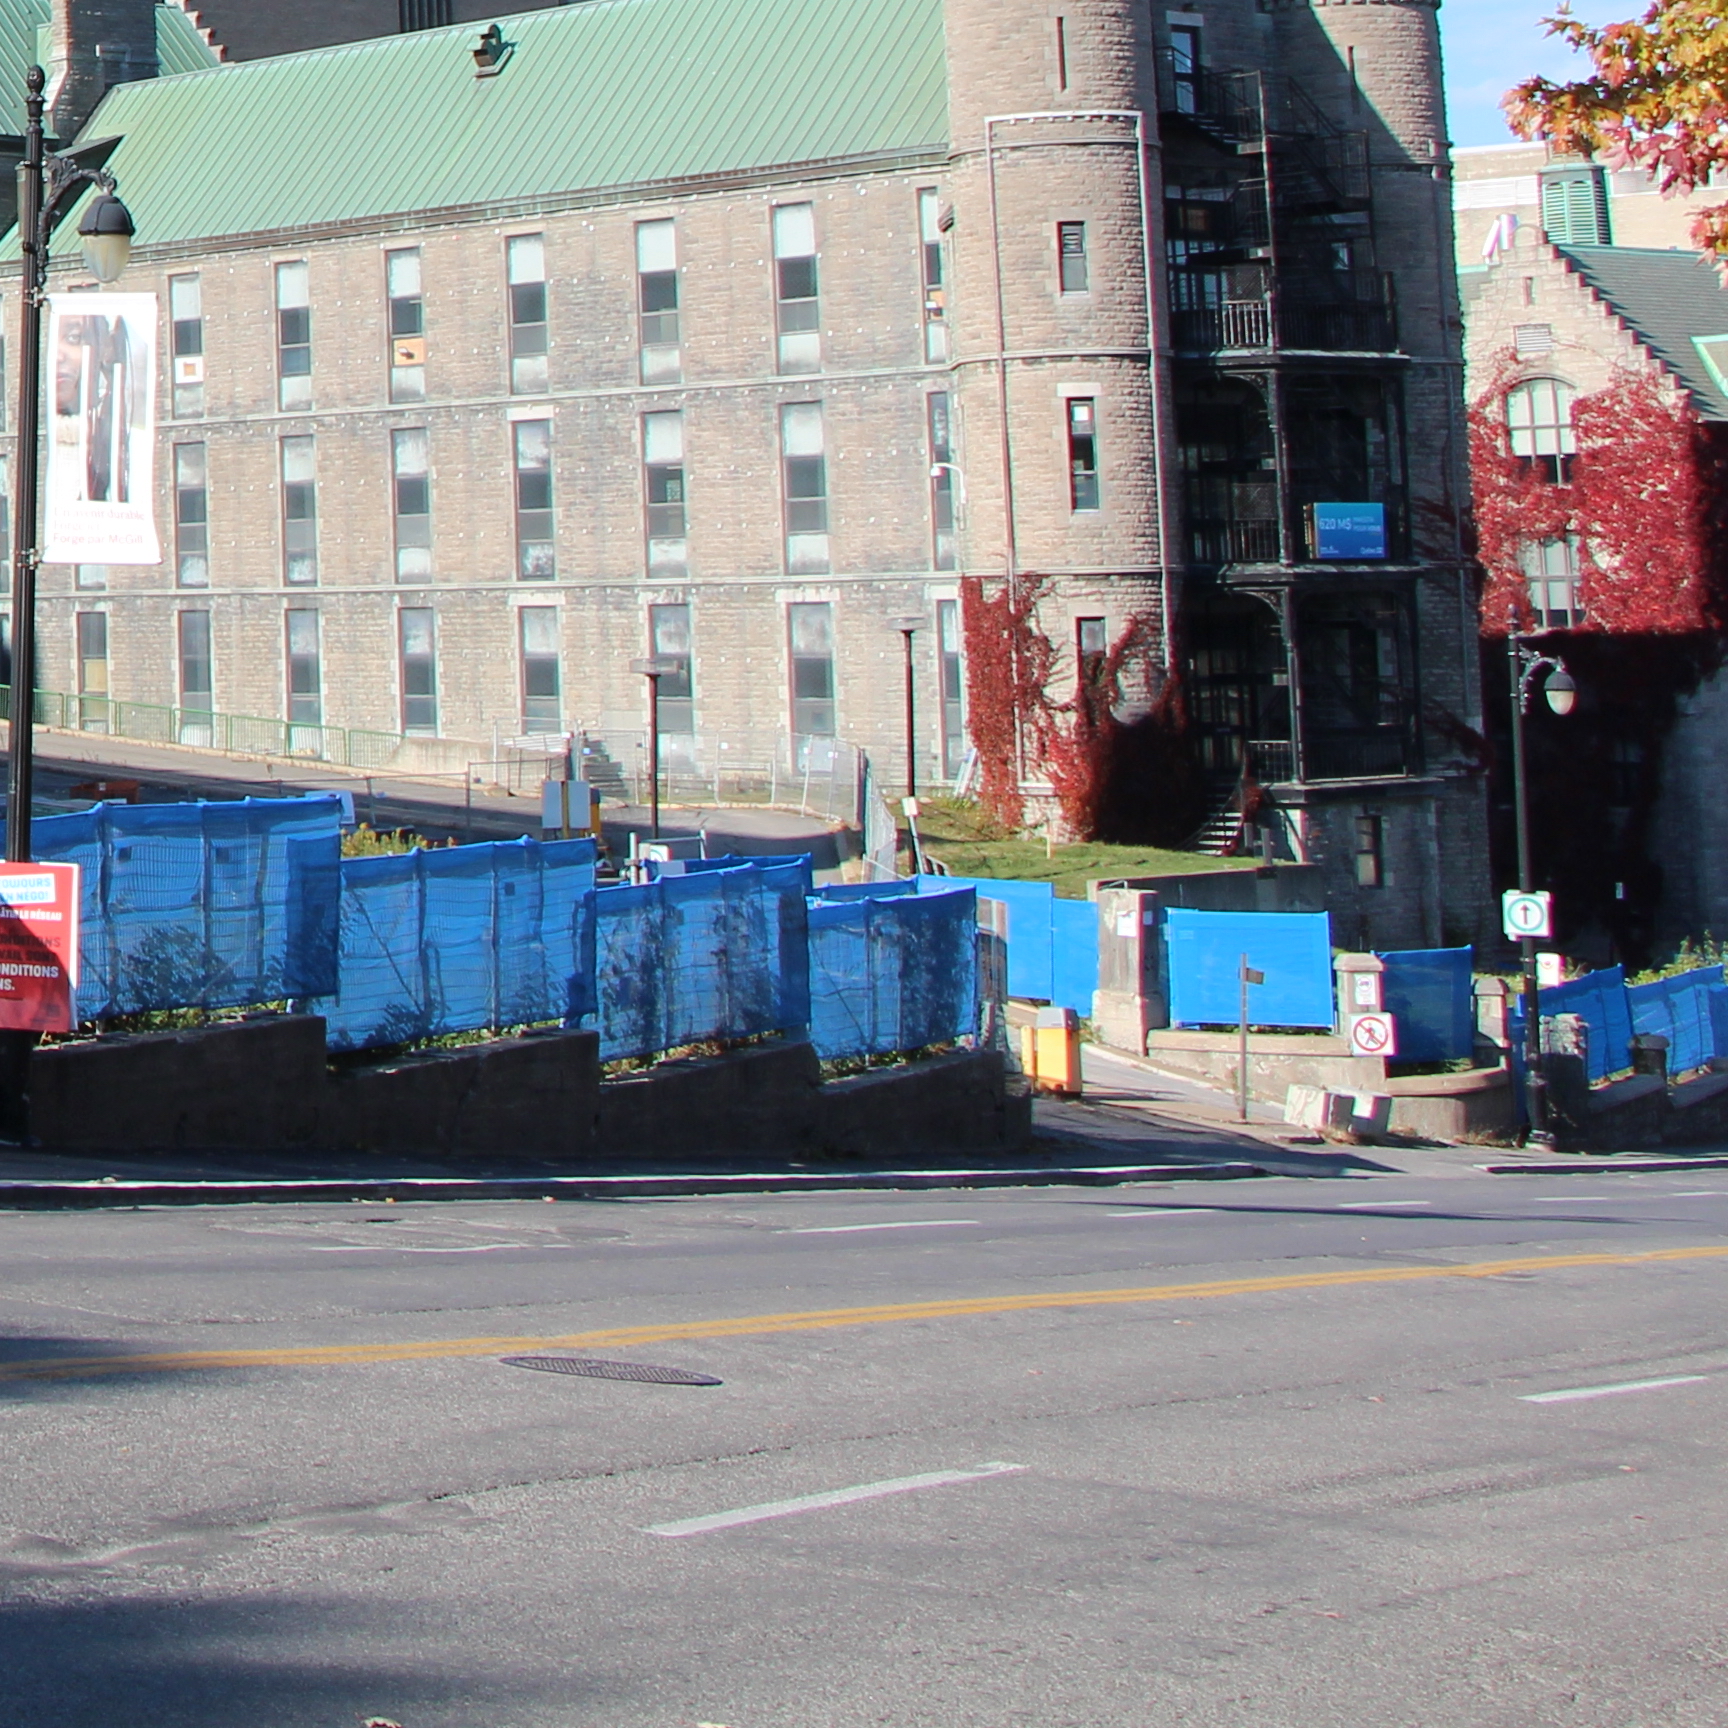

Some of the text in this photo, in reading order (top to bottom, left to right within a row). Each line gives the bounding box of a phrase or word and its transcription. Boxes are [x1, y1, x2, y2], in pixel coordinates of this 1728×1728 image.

[107, 509, 144, 521] durable
[1319, 518, 1336, 530] 620
[87, 535, 105, 545] par
[108, 533, 143, 544] McGill
[20, 910, 29, 919] LE
[30, 908, 62, 921] RÉSEAU
